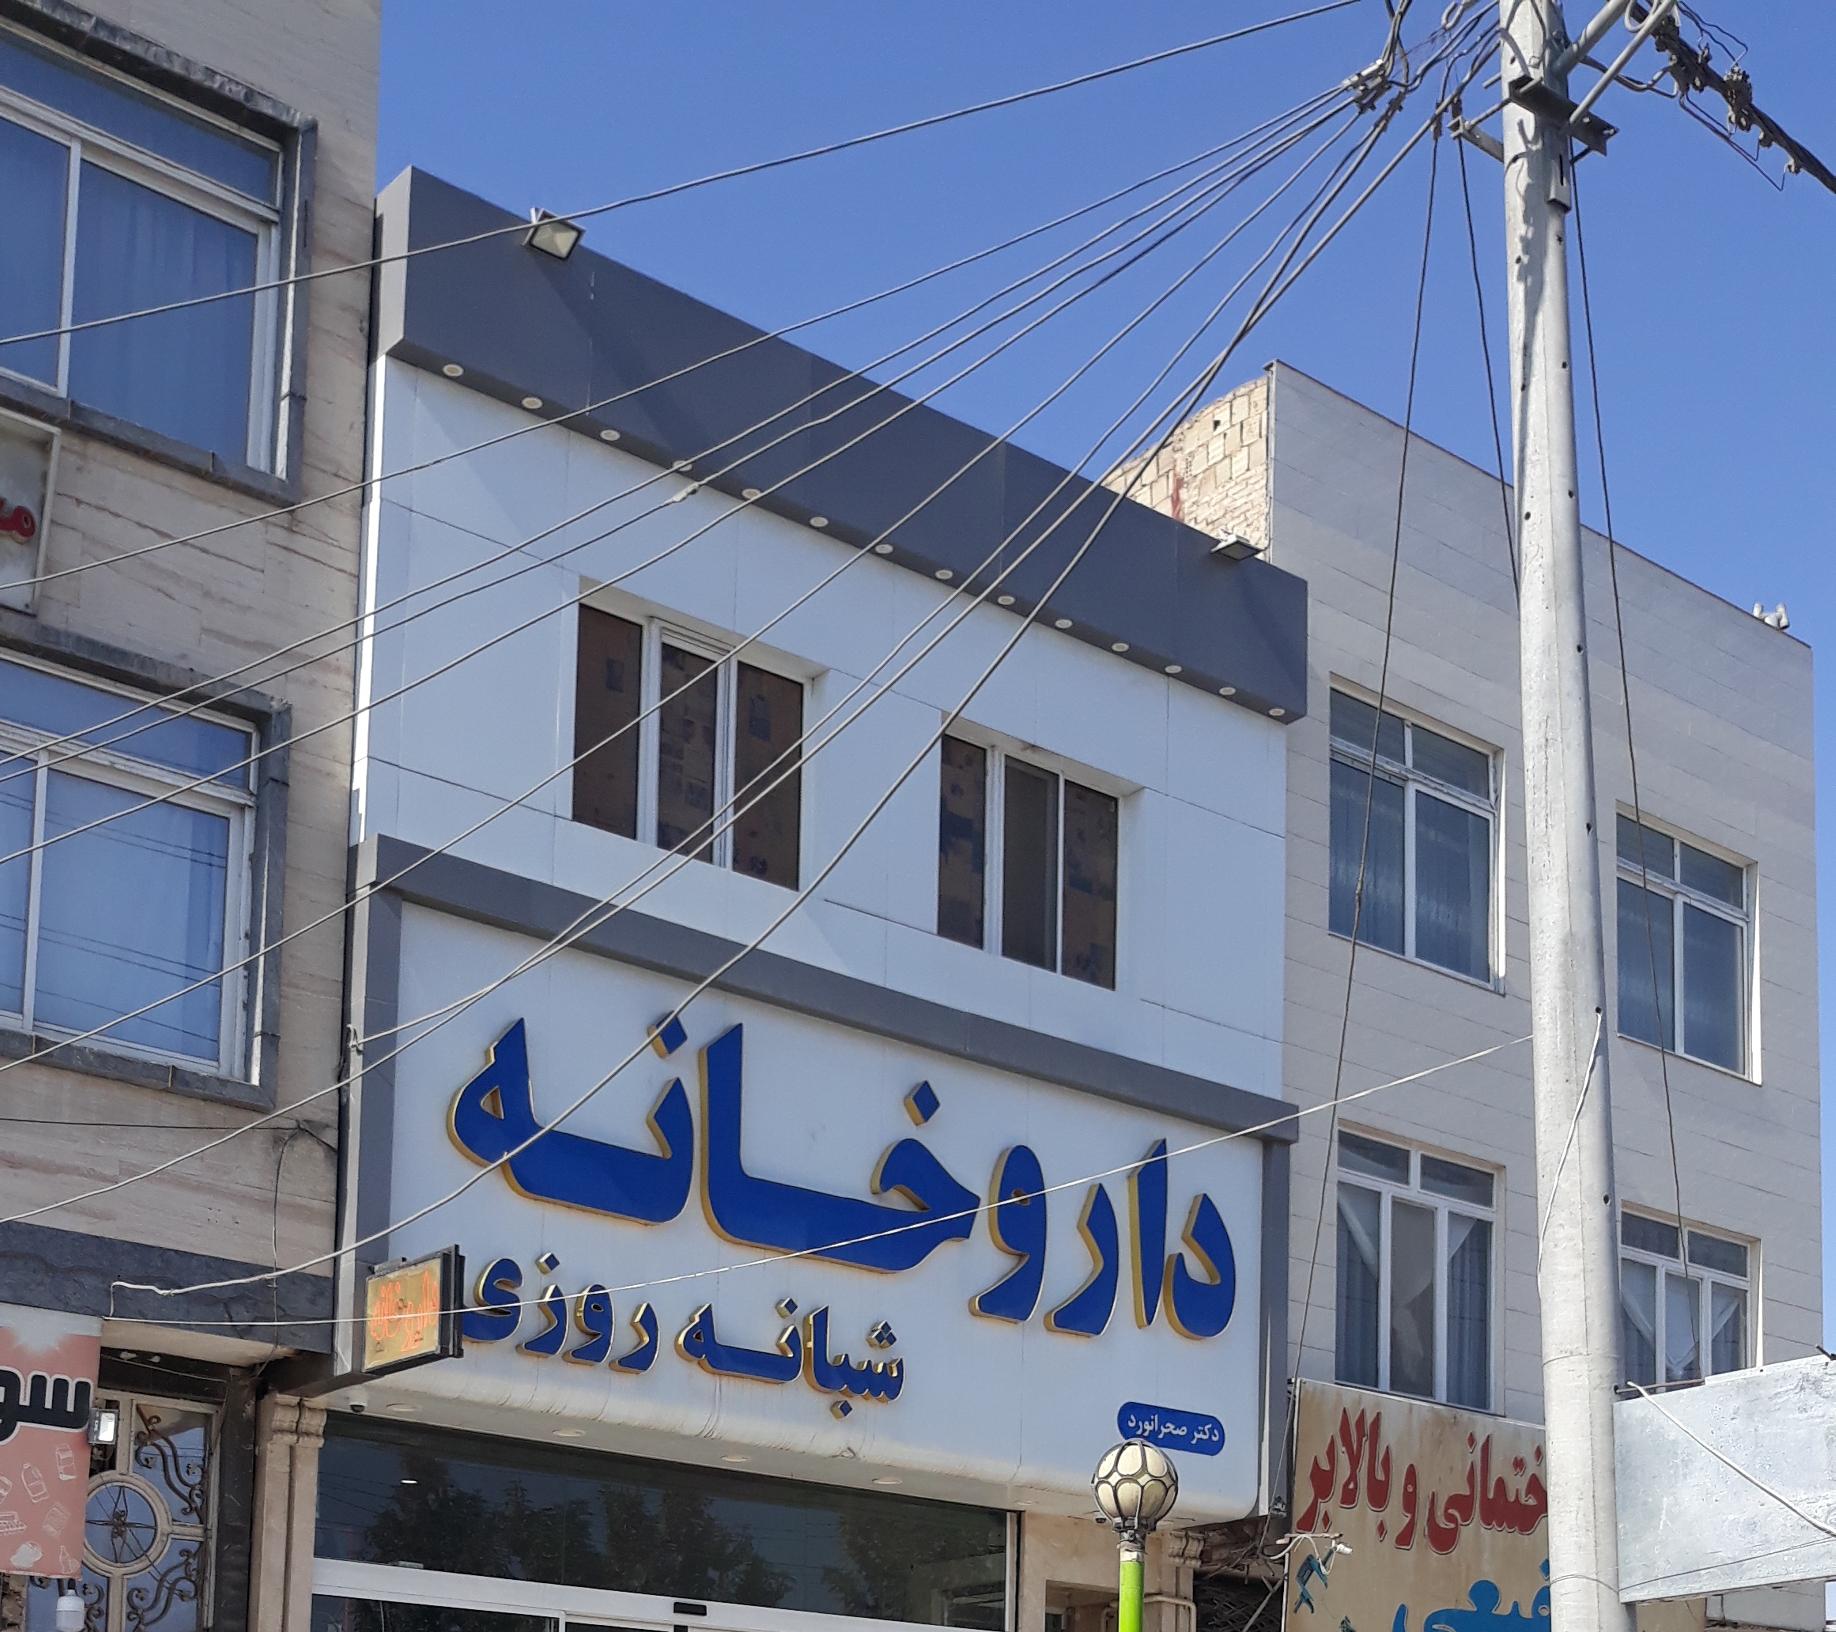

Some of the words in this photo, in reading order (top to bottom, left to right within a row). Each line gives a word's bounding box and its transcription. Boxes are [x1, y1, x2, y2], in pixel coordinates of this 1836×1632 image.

[447, 1010, 1237, 1340] داروخانه
[463, 1252, 660, 1375] روزی
[675, 1296, 905, 1420] شبانه
[1127, 1414, 1188, 1439] صحرانورد
[1191, 1424, 1220, 1444] دکتر
[1427, 1431, 1548, 1554] ختمانی
